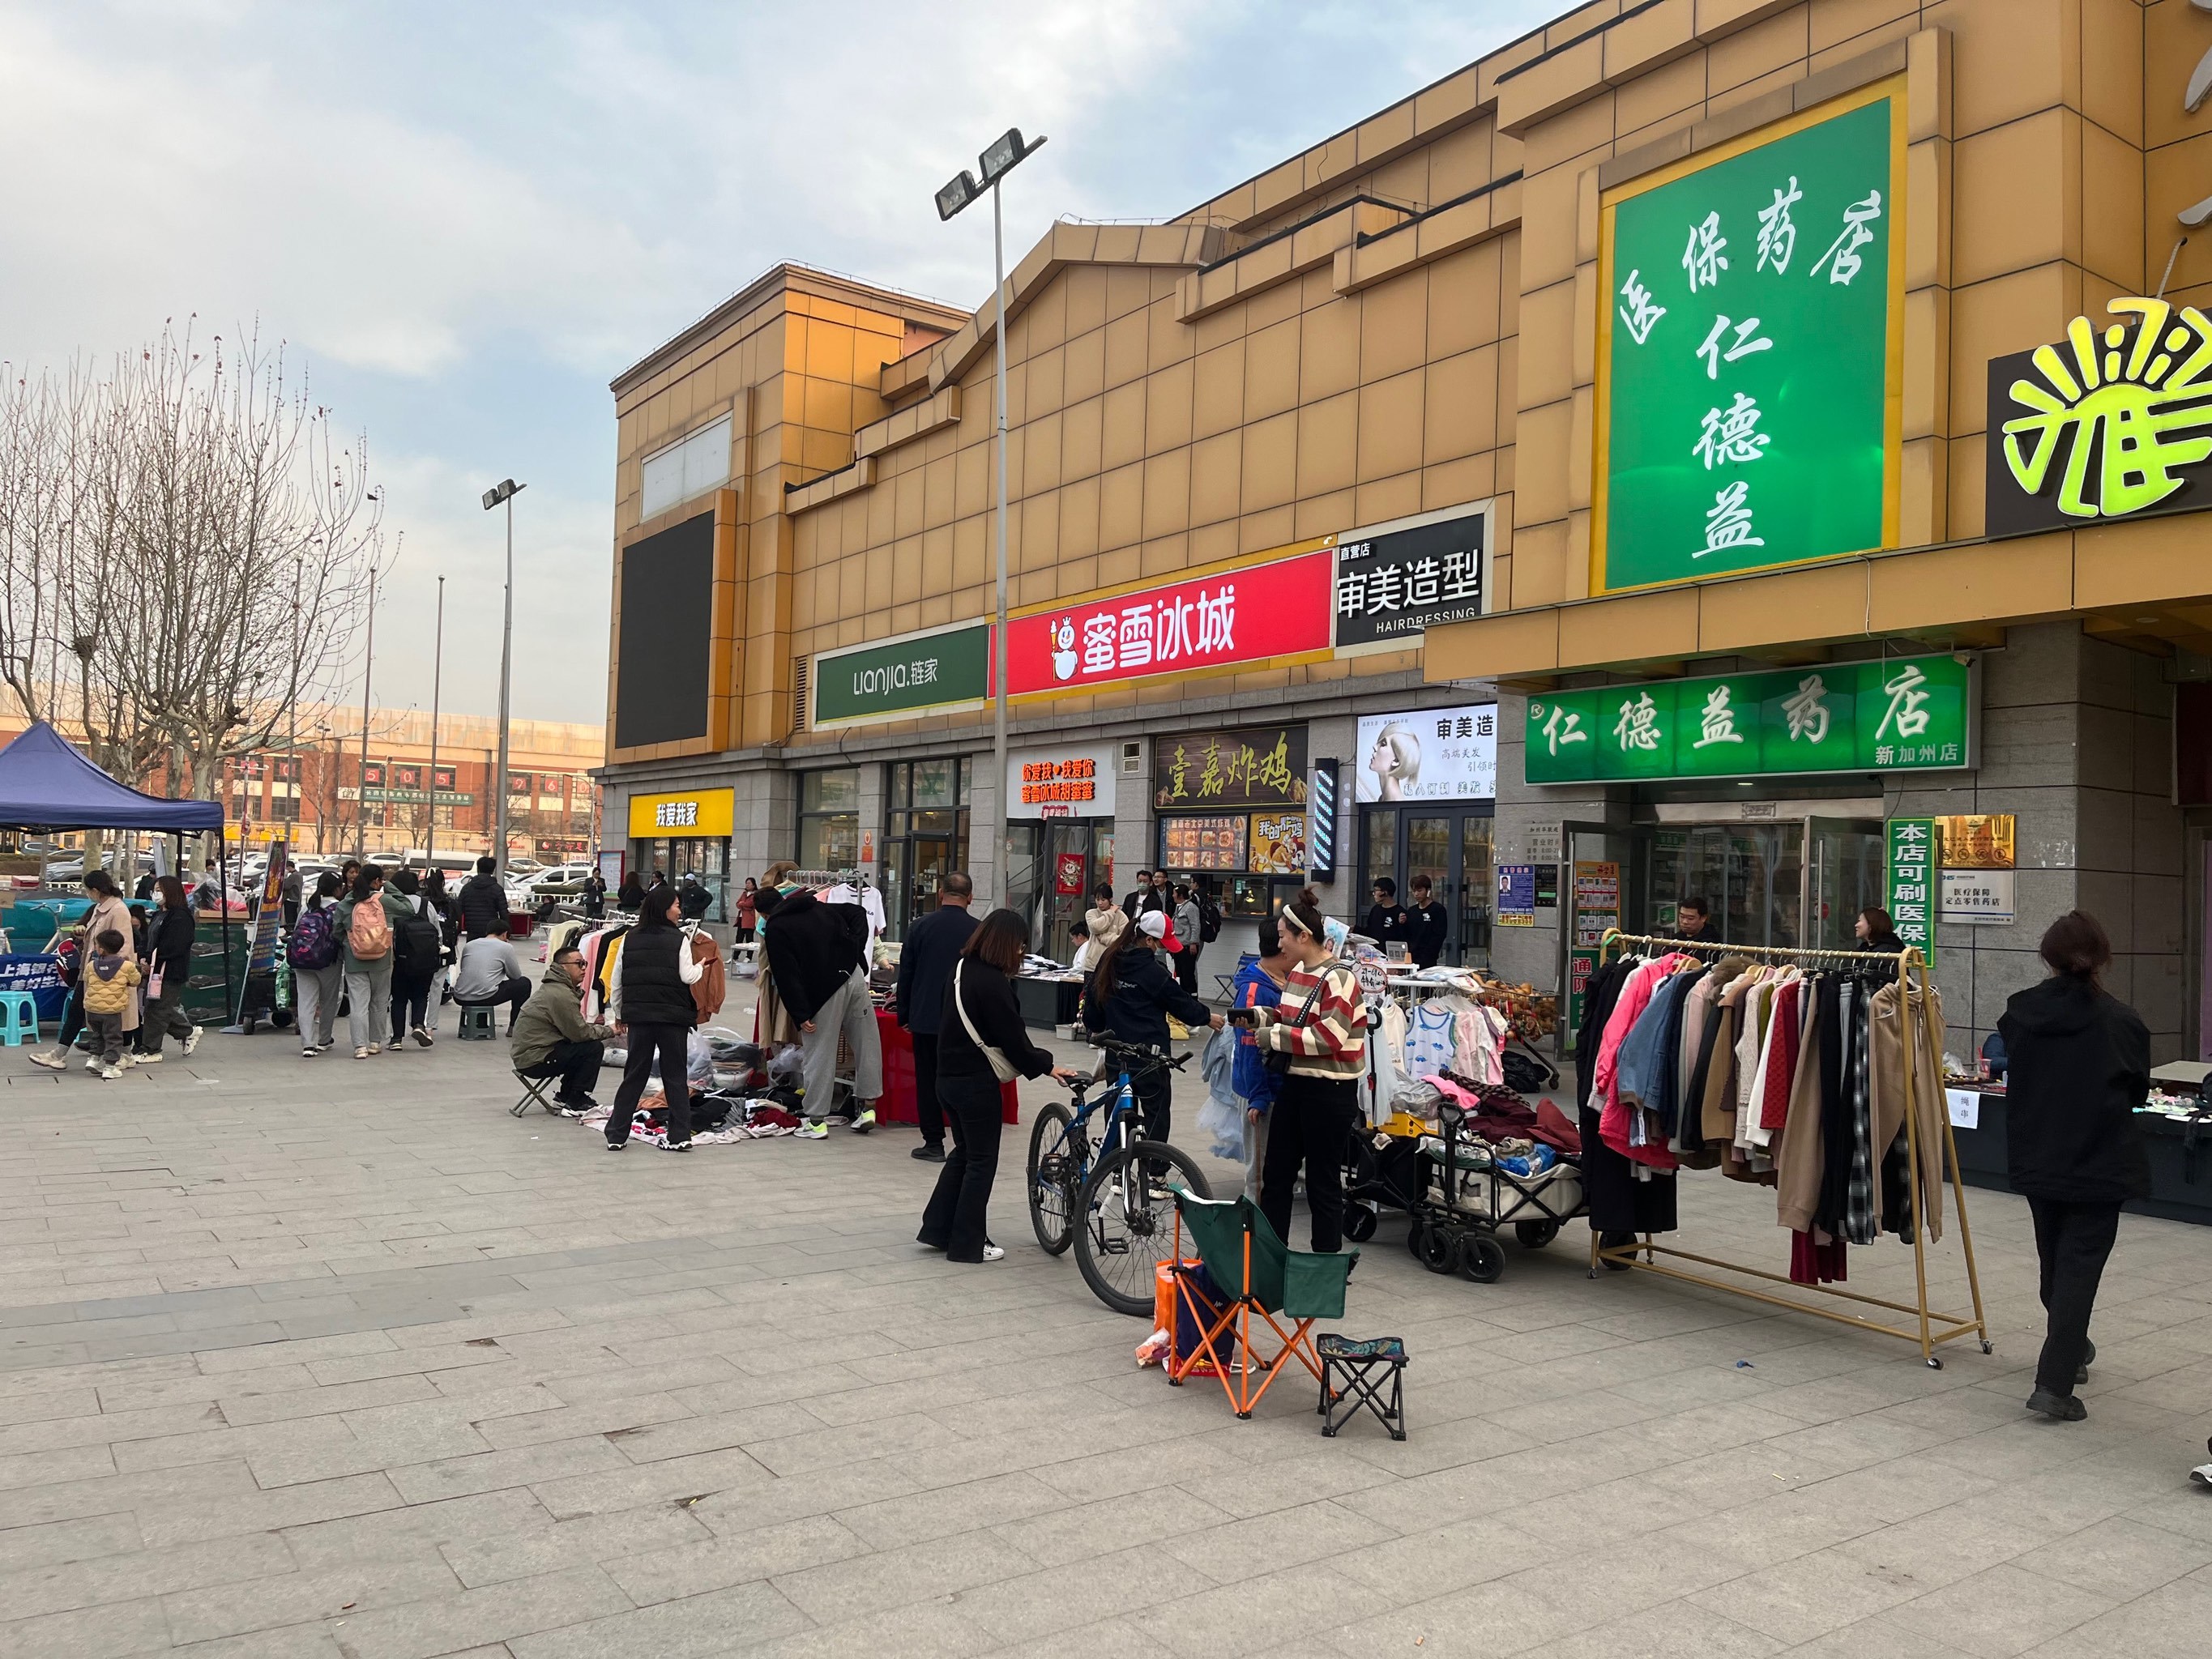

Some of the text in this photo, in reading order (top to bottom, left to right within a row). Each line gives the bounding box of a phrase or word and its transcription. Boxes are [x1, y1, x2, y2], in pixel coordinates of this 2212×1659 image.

[1340, 543, 1371, 561] 直营店
[1337, 548, 1480, 619] 审美造型
[1083, 585, 1235, 674] 蜜雪冰城
[1542, 665, 1931, 757] 仁德益药店
[1437, 714, 1493, 740] 审美造
[1169, 731, 1292, 798] 壹嘉炸鸡
[1441, 747, 1481, 760] 高端美发
[1875, 743, 1958, 765] 新加州店
[1021, 781, 1095, 804] 蜜雪冰城甜蜜蜜
[1404, 782, 1450, 796] 私人订制
[655, 802, 698, 827] 我爱我家
[1945, 897, 2001, 906] 定点零售药店
[1954, 888, 1990, 897] 医疗保障
